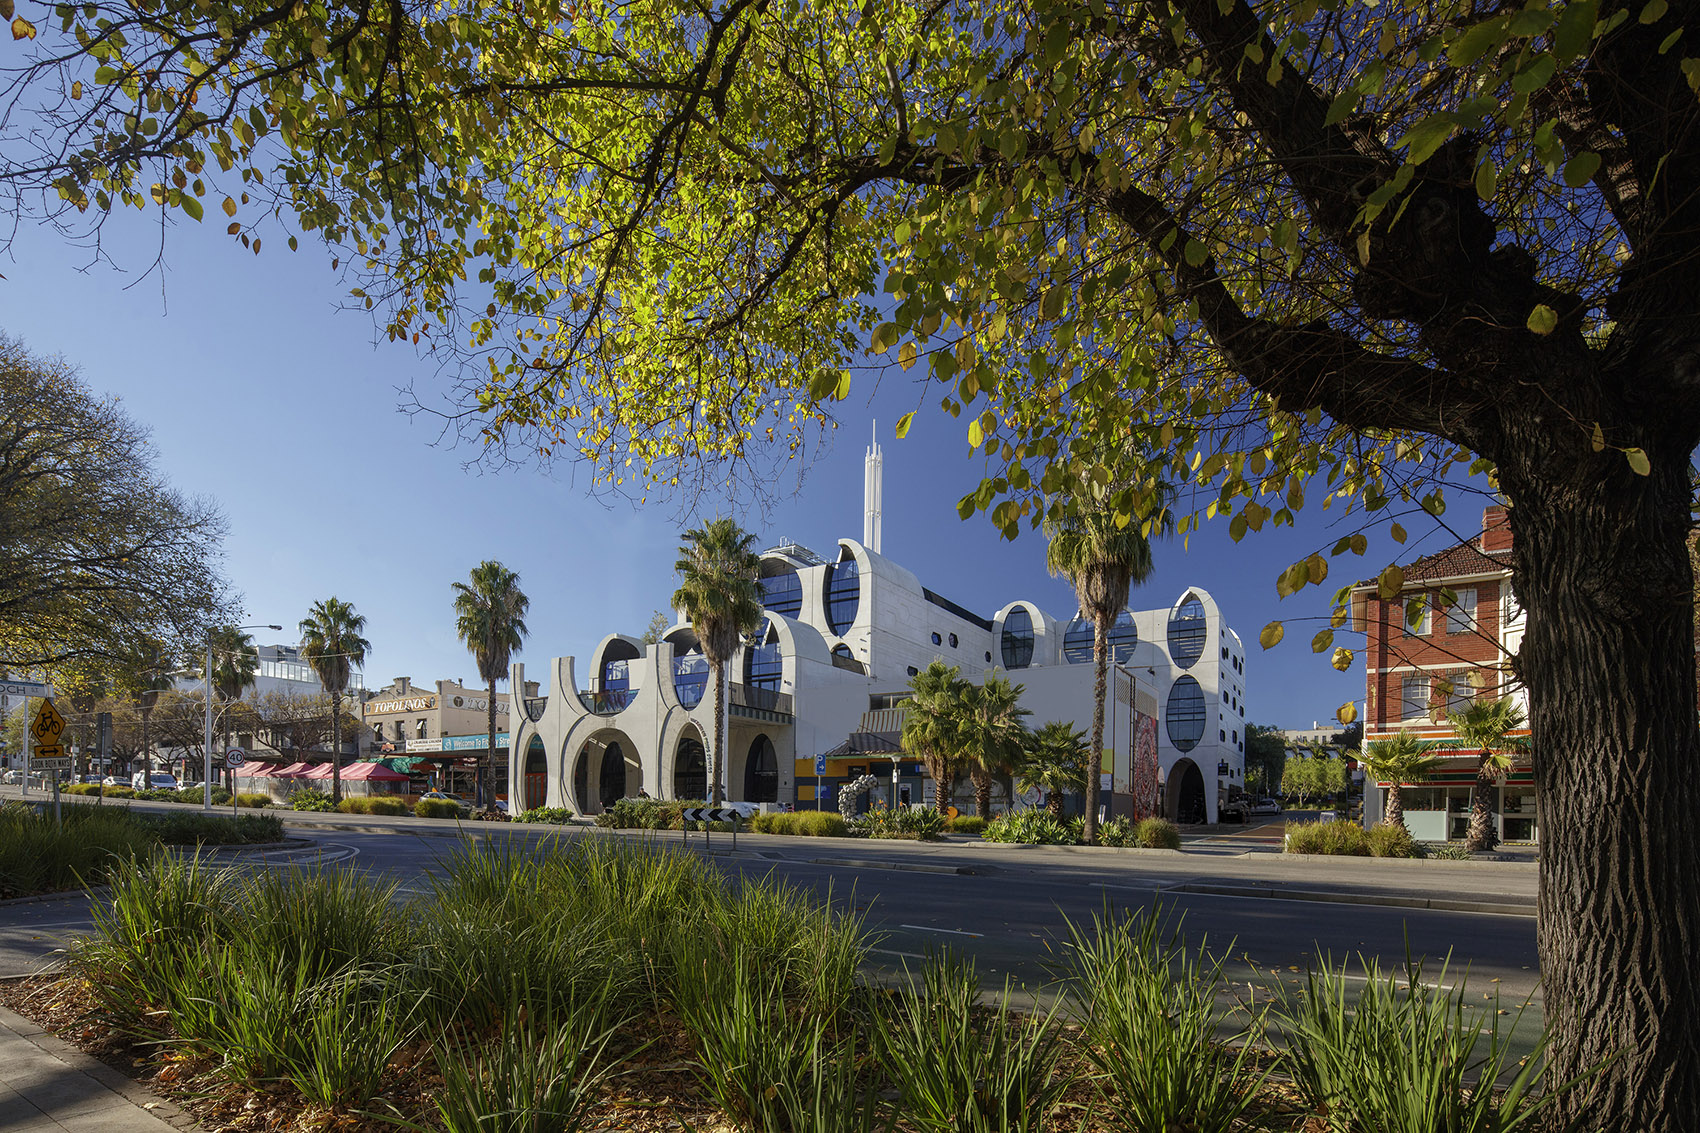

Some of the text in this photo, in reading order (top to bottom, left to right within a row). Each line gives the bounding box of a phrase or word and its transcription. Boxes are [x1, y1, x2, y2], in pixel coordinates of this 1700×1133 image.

[374, 698, 427, 713] TOPOLINOS
[468, 697, 510, 715] TOOL
[453, 739, 475, 748] Welcome
[475, 738, 481, 746] To
[32, 758, 70, 768] LOOK BOTH WAYS
[230, 754, 242, 762] 40
[816, 755, 823, 764] P
